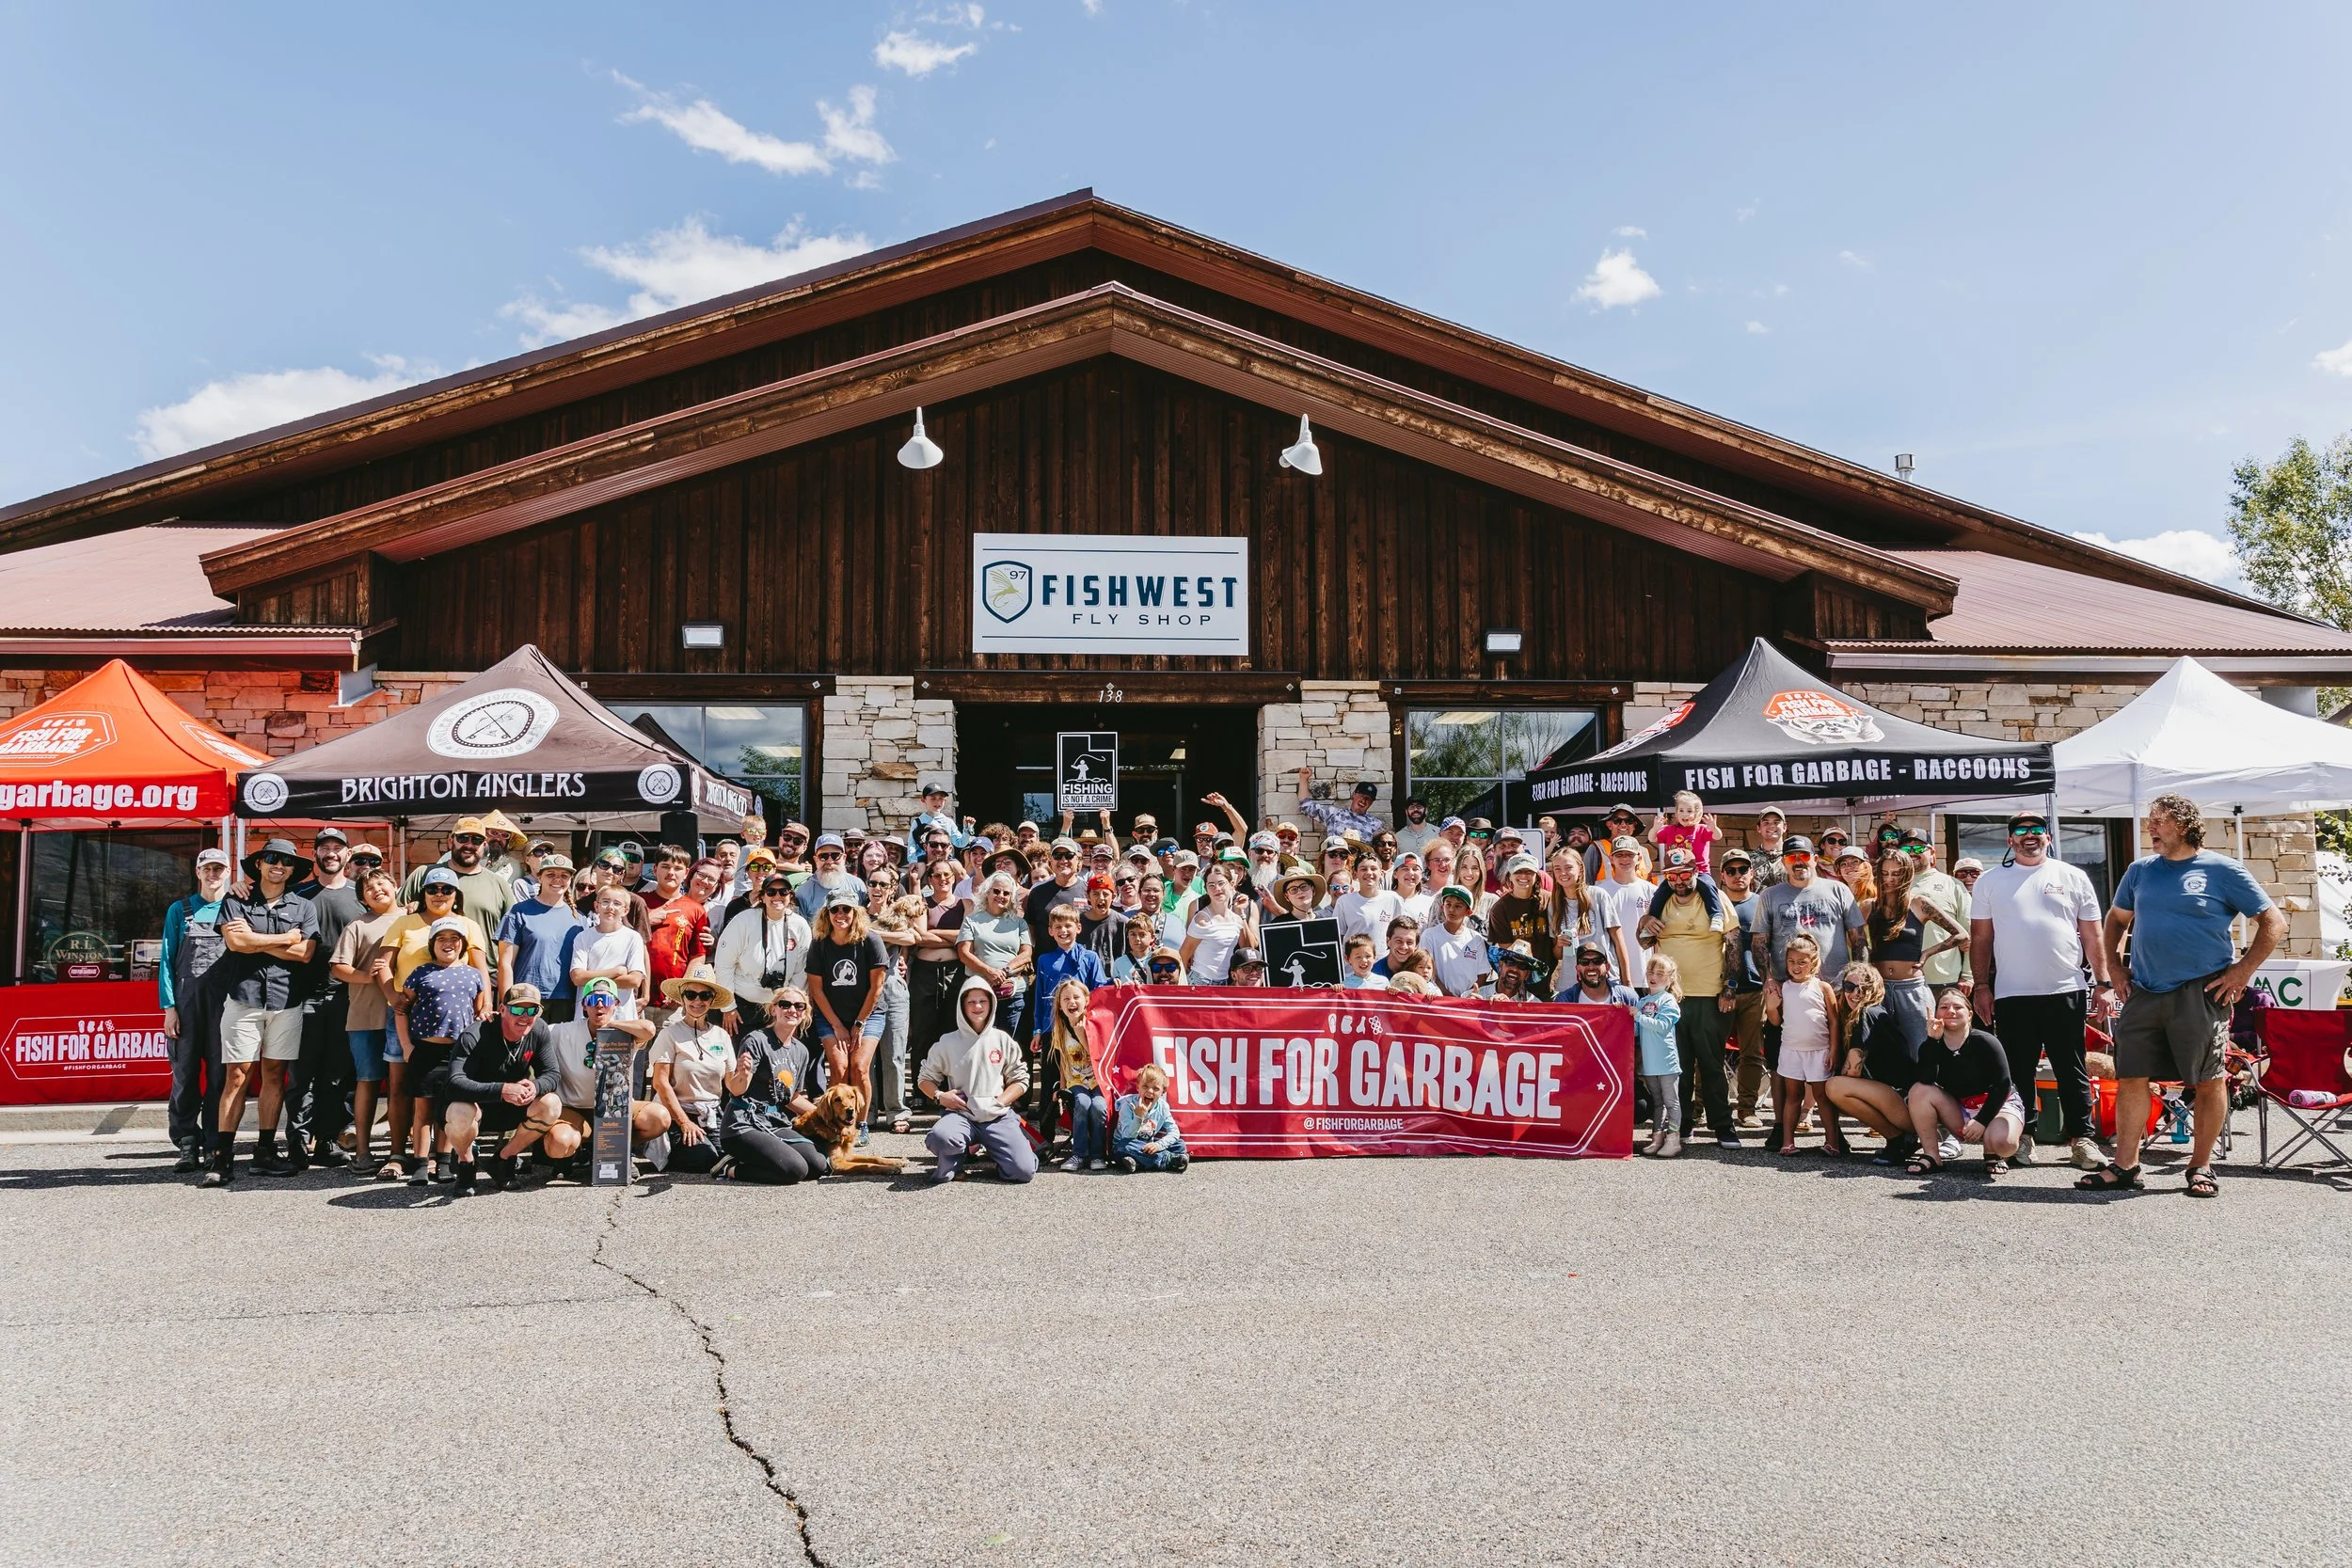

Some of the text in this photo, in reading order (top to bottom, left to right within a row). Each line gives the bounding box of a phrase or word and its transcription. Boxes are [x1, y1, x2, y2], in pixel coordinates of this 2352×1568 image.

[1009, 570, 1026, 580] 97
[1042, 574, 1238, 609] FISHWEST
[1073, 613, 1211, 626] FLY SHOP
[1099, 689, 1123, 704] 138
[1777, 699, 1809, 711] FISH
[8, 727, 94, 743] FISH FOR
[1685, 767, 1736, 790] FISH
[1743, 765, 1785, 787] FOR
[1791, 758, 1892, 784] GARBAGE
[1914, 757, 2031, 781] RACCOONS
[342, 772, 586, 803] BRIGHTON ANGLERS
[1062, 784, 1113, 794] FISHING
[1532, 783, 1547, 801] FISH
[1547, 779, 1560, 799] FOR
[1561, 773, 1594, 797] GARBAGE
[1600, 770, 1647, 792] RACCOONS
[1062, 795, 1113, 803] IS NOT A CRIME
[71, 940, 95, 950] R.L.
[16, 1036, 54, 1062] FISH
[57, 1034, 90, 1061] FOR
[63, 1063, 127, 1071] #FISHFORGARBAGE
[1152, 1036, 1564, 1120] FISH FOR GARBAGE
[1303, 1117, 1405, 1132] @FISHFORGARBAGE
